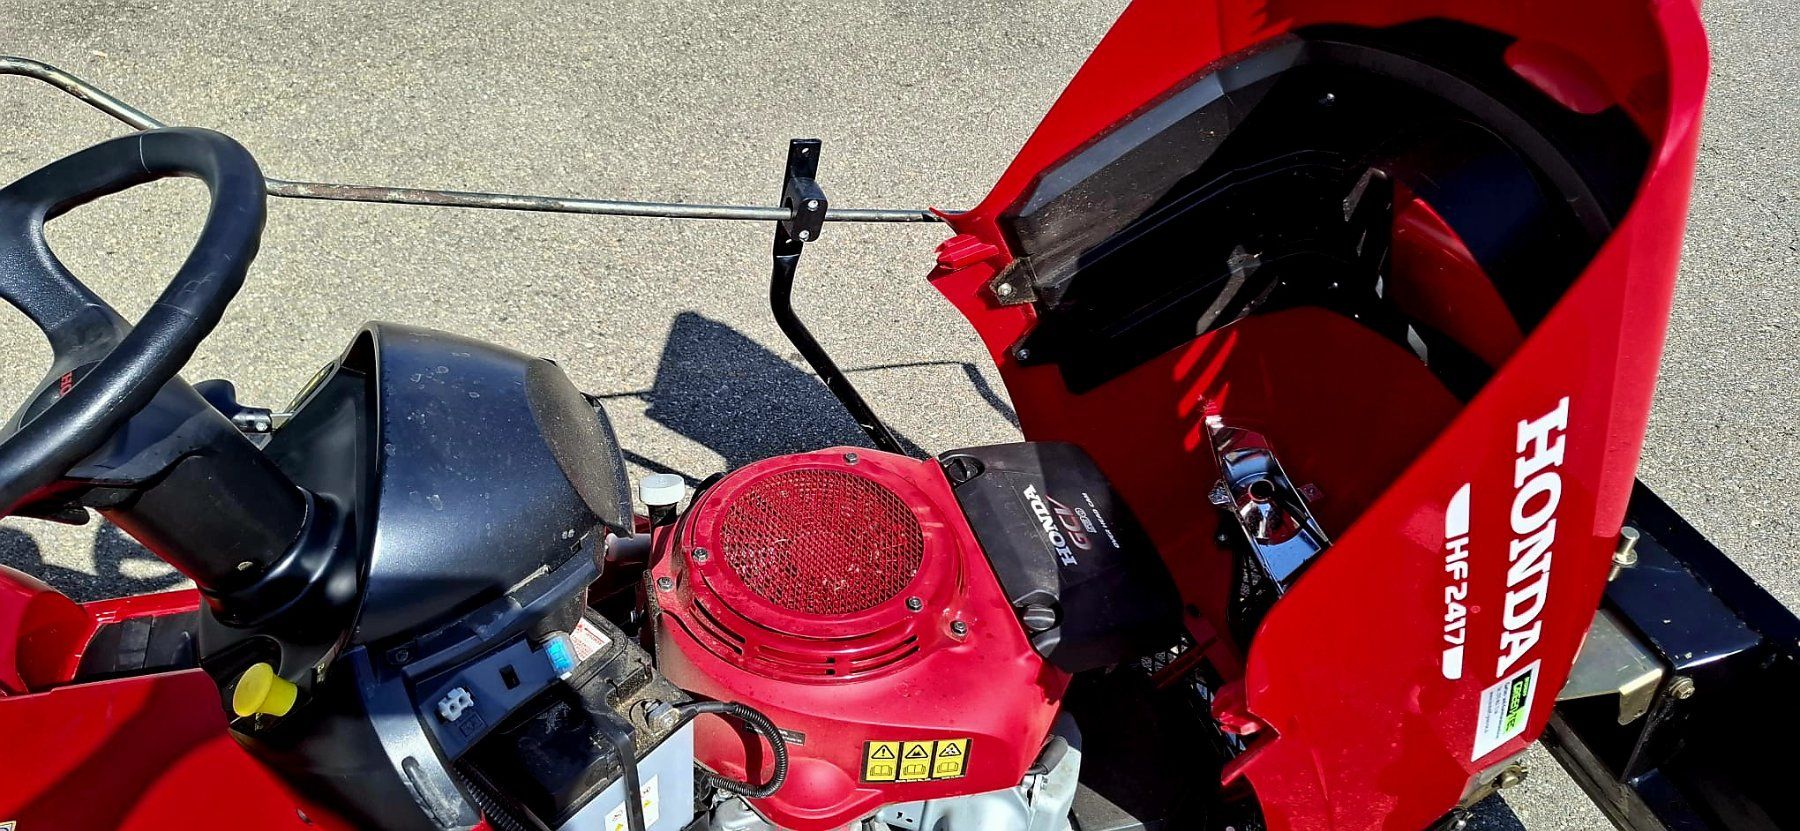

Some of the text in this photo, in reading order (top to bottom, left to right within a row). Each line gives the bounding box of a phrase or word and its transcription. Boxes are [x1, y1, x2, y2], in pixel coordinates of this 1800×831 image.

[1023, 484, 1078, 566] HONDA
[1044, 494, 1091, 550] GCV
[1496, 396, 1570, 679] HONDA
[1443, 582, 1468, 645] 2417
